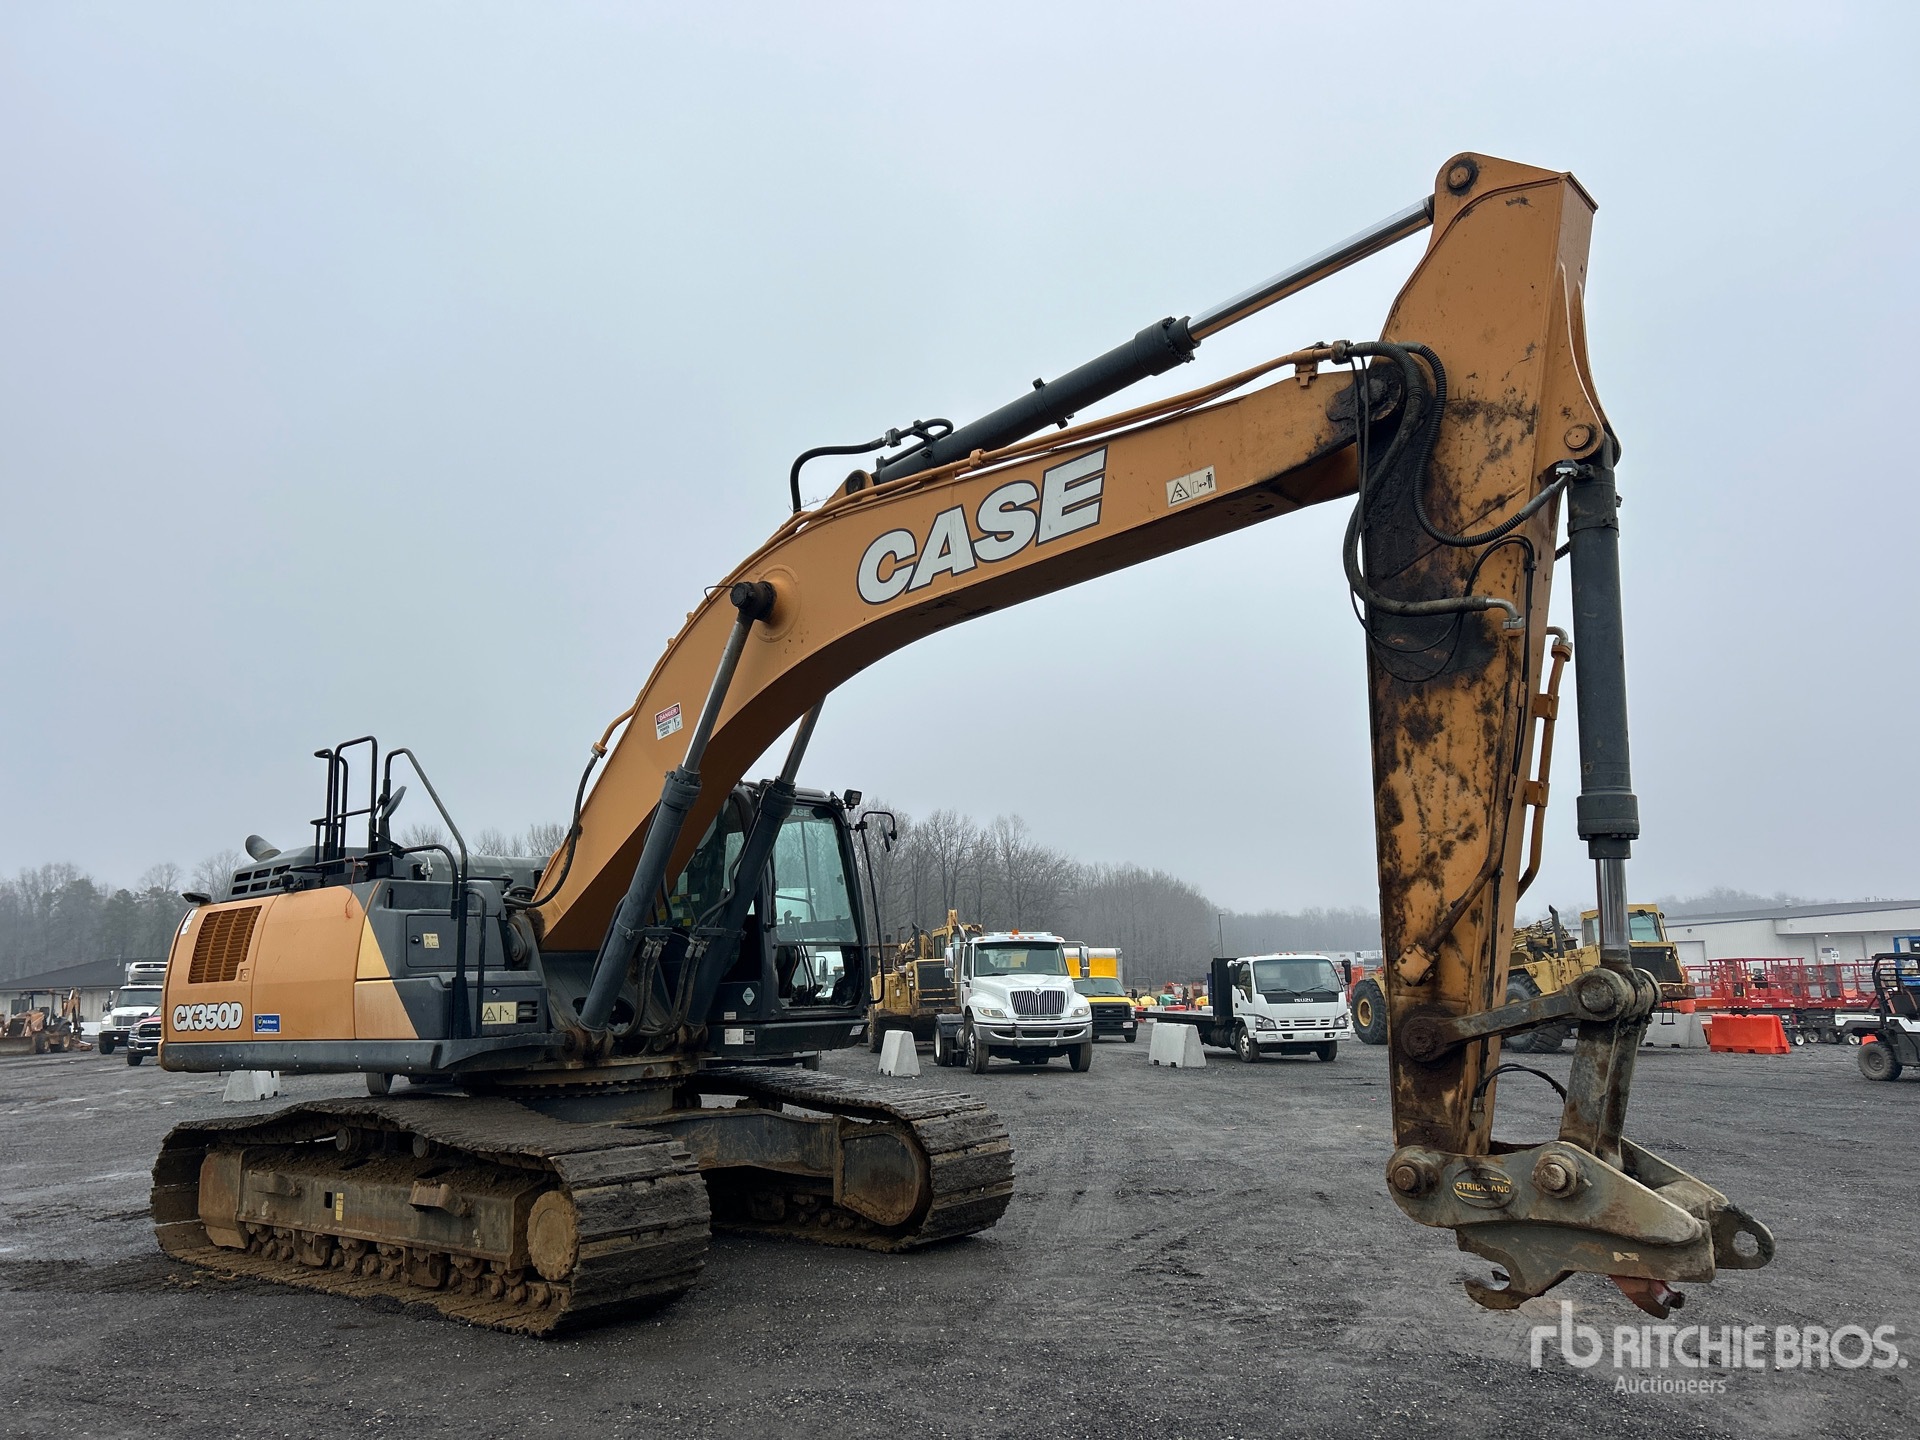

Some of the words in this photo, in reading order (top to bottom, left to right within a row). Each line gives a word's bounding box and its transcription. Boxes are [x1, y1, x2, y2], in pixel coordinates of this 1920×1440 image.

[857, 445, 1108, 605] CASE
[790, 808, 810, 817] ASE
[172, 1001, 243, 1032] CX350D
[1456, 1182, 1510, 1193] STRICKAND
